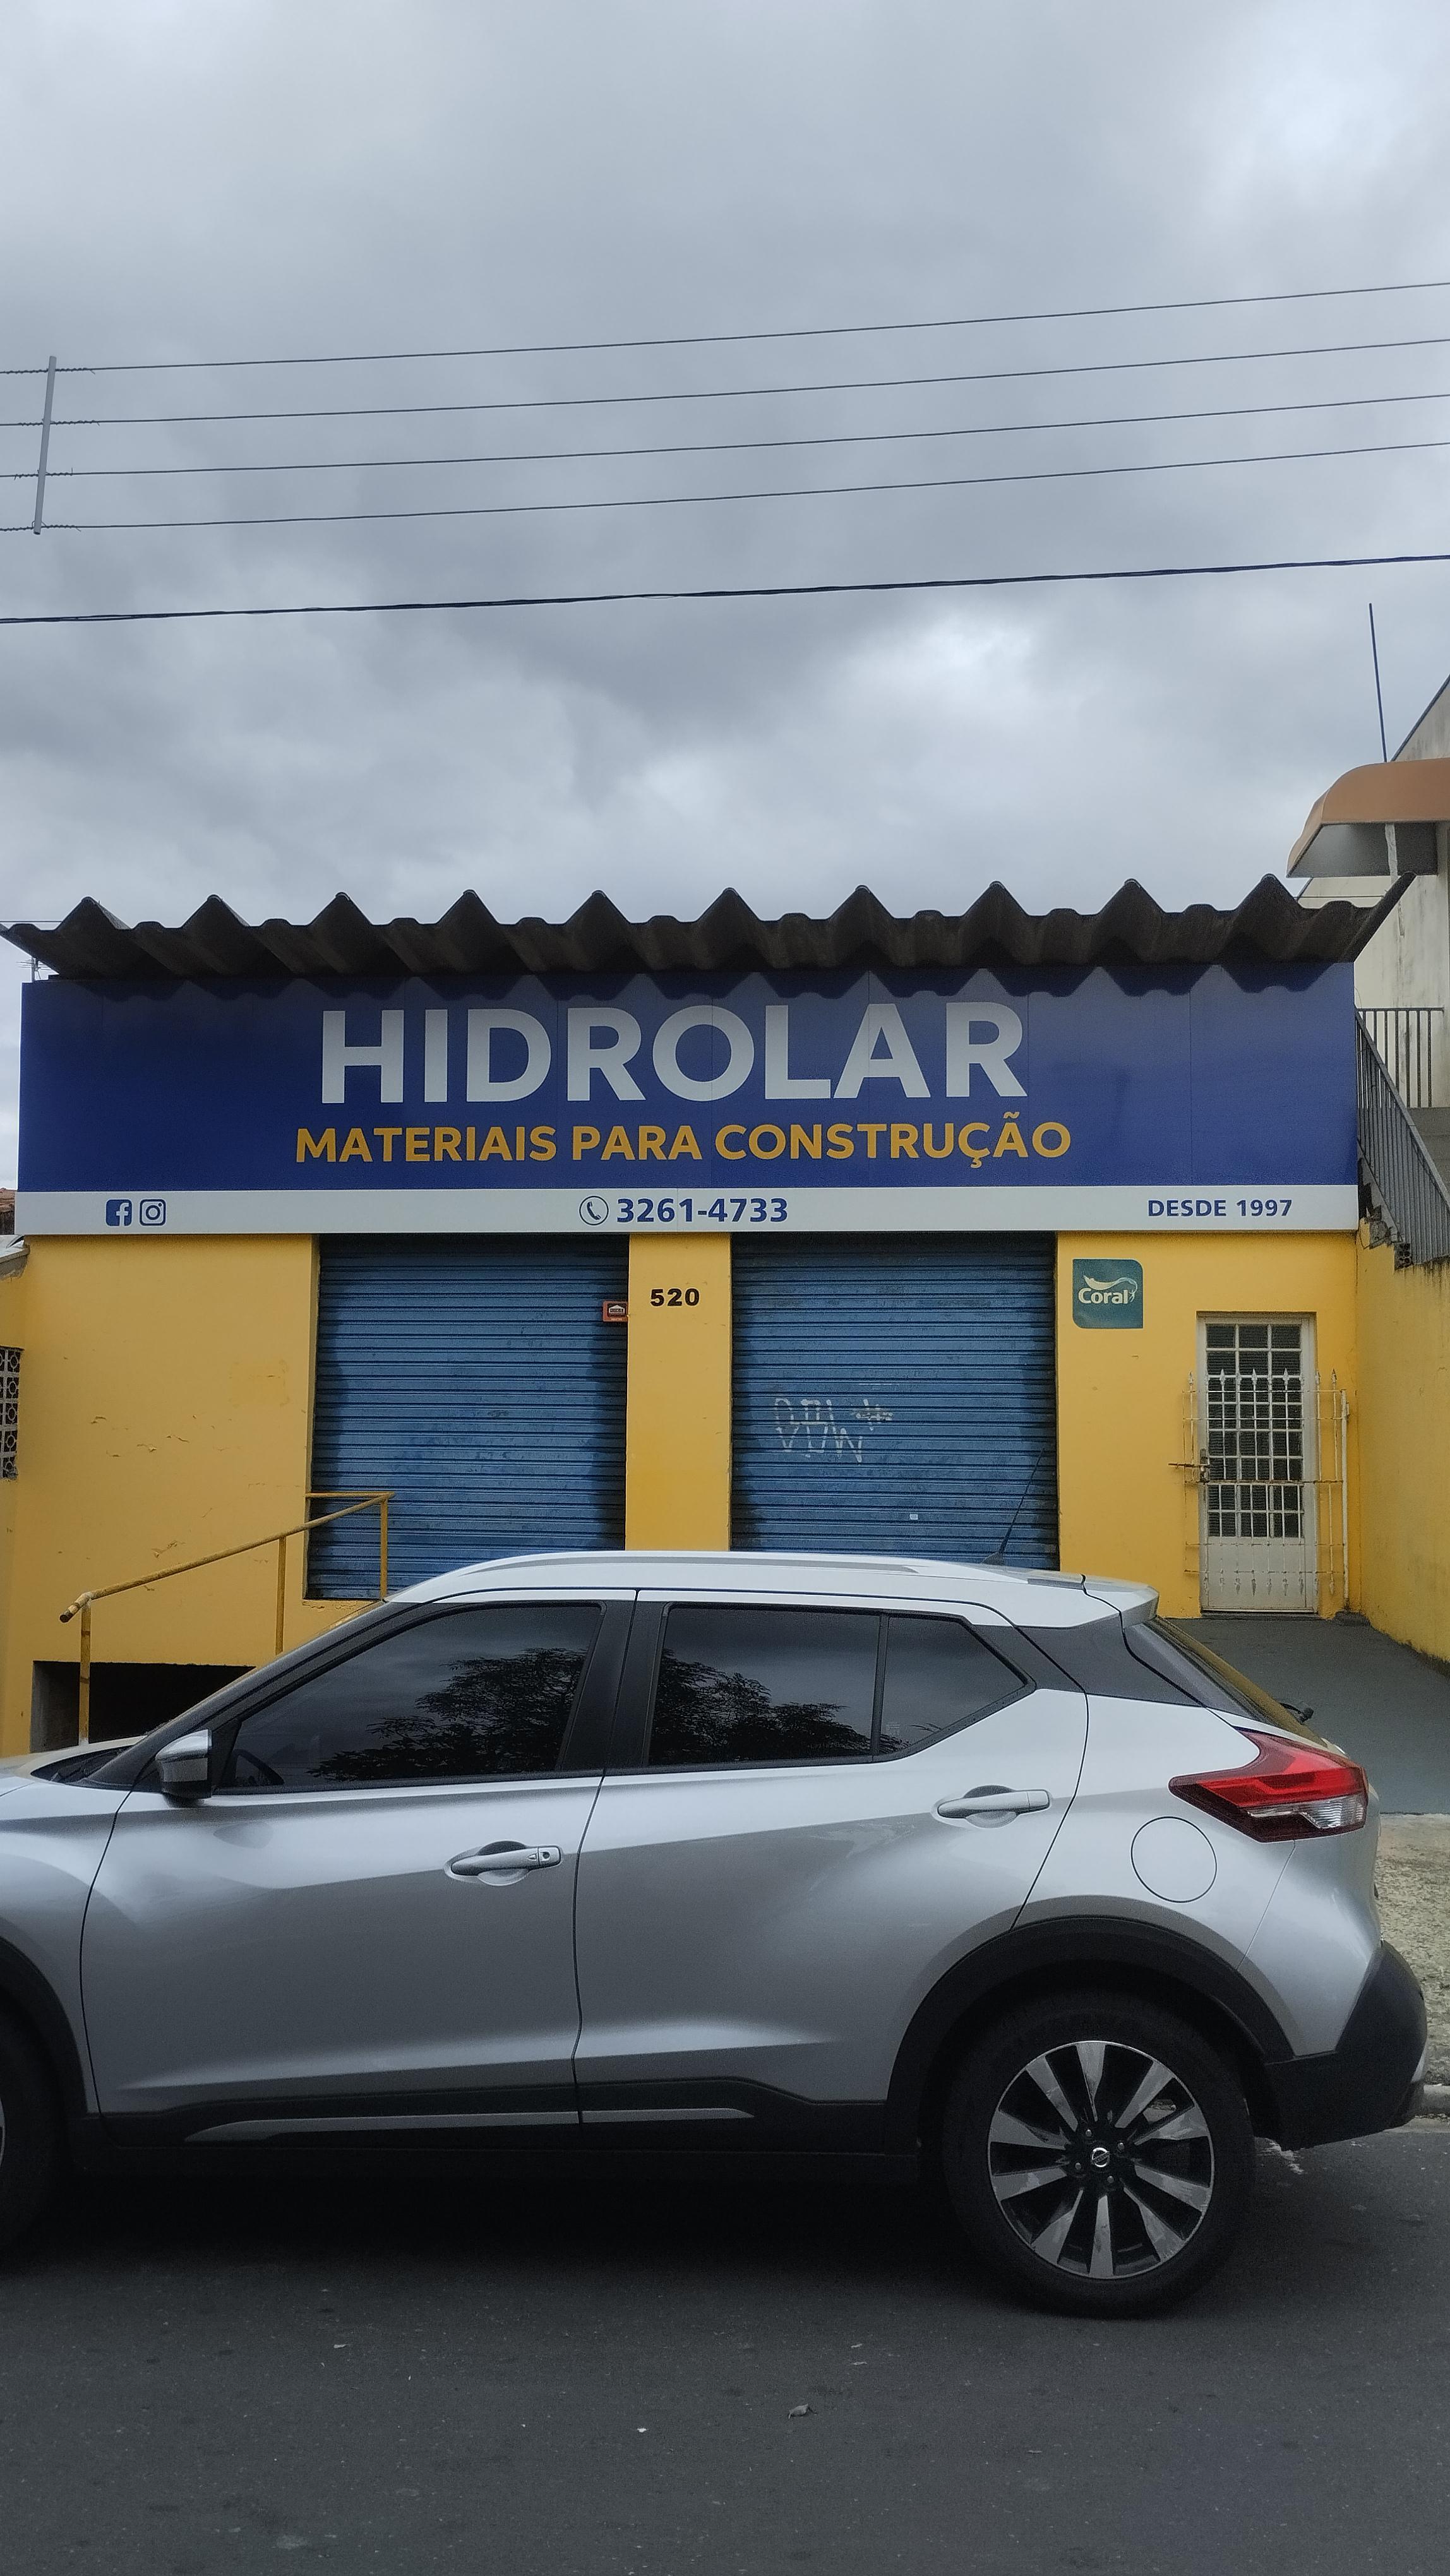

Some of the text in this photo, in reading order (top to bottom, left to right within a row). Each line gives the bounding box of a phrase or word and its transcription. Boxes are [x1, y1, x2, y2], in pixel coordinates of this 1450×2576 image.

[321, 1001, 1028, 1104] HIDROLAR
[296, 1111, 1071, 1169] MATERIAIS PARA CONSTRUÇÃO
[616, 1198, 788, 1223] 3261-4733
[1147, 1199, 1292, 1217] DESDE 1997
[650, 1288, 700, 1307] 520
[1078, 1287, 1129, 1304] Coral
